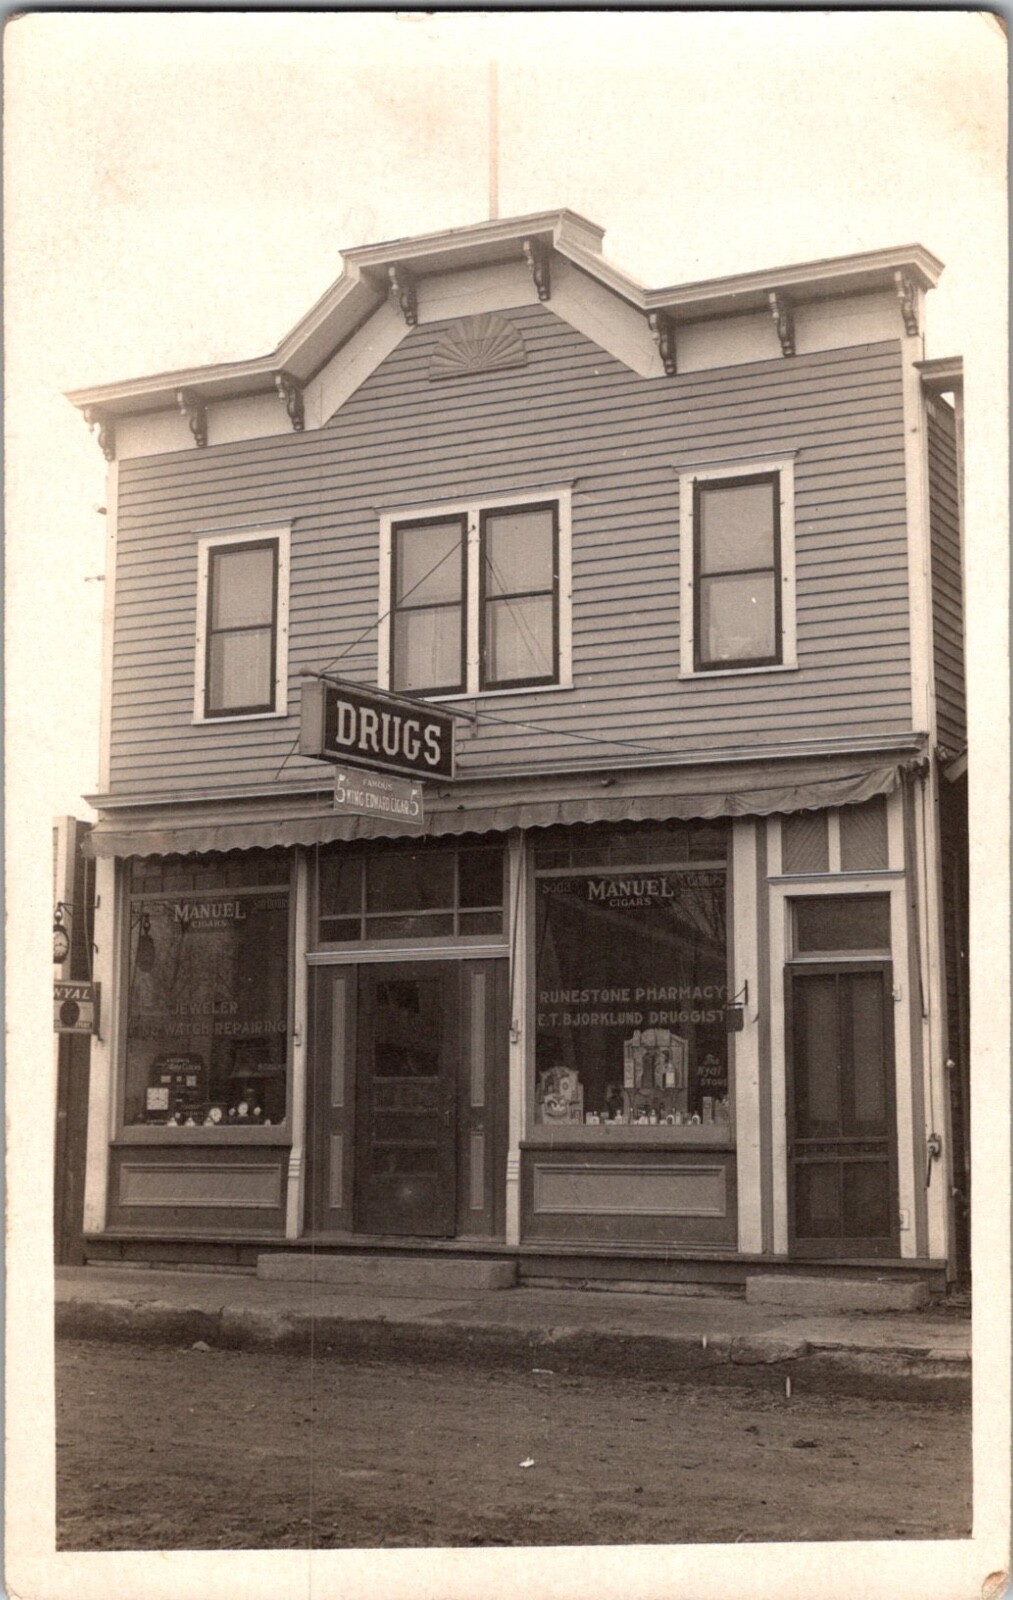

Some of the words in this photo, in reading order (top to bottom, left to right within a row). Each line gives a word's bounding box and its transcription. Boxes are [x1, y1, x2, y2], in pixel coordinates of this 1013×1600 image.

[336, 700, 441, 766] DRUGS
[362, 779, 393, 791] FAMOUS
[587, 877, 675, 901] MANUEL
[609, 898, 651, 907] CIGARS
[174, 901, 246, 922] MANUEL
[191, 919, 227, 928] CIGARS
[539, 988, 631, 1004] RUNESTONE
[635, 985, 725, 1003] PHARMACY
[171, 1001, 238, 1015] JEWELER
[650, 1010, 724, 1024] DRUGGIST
[164, 1021, 209, 1036] WATCH
[214, 1020, 287, 1035] REPAIRING
